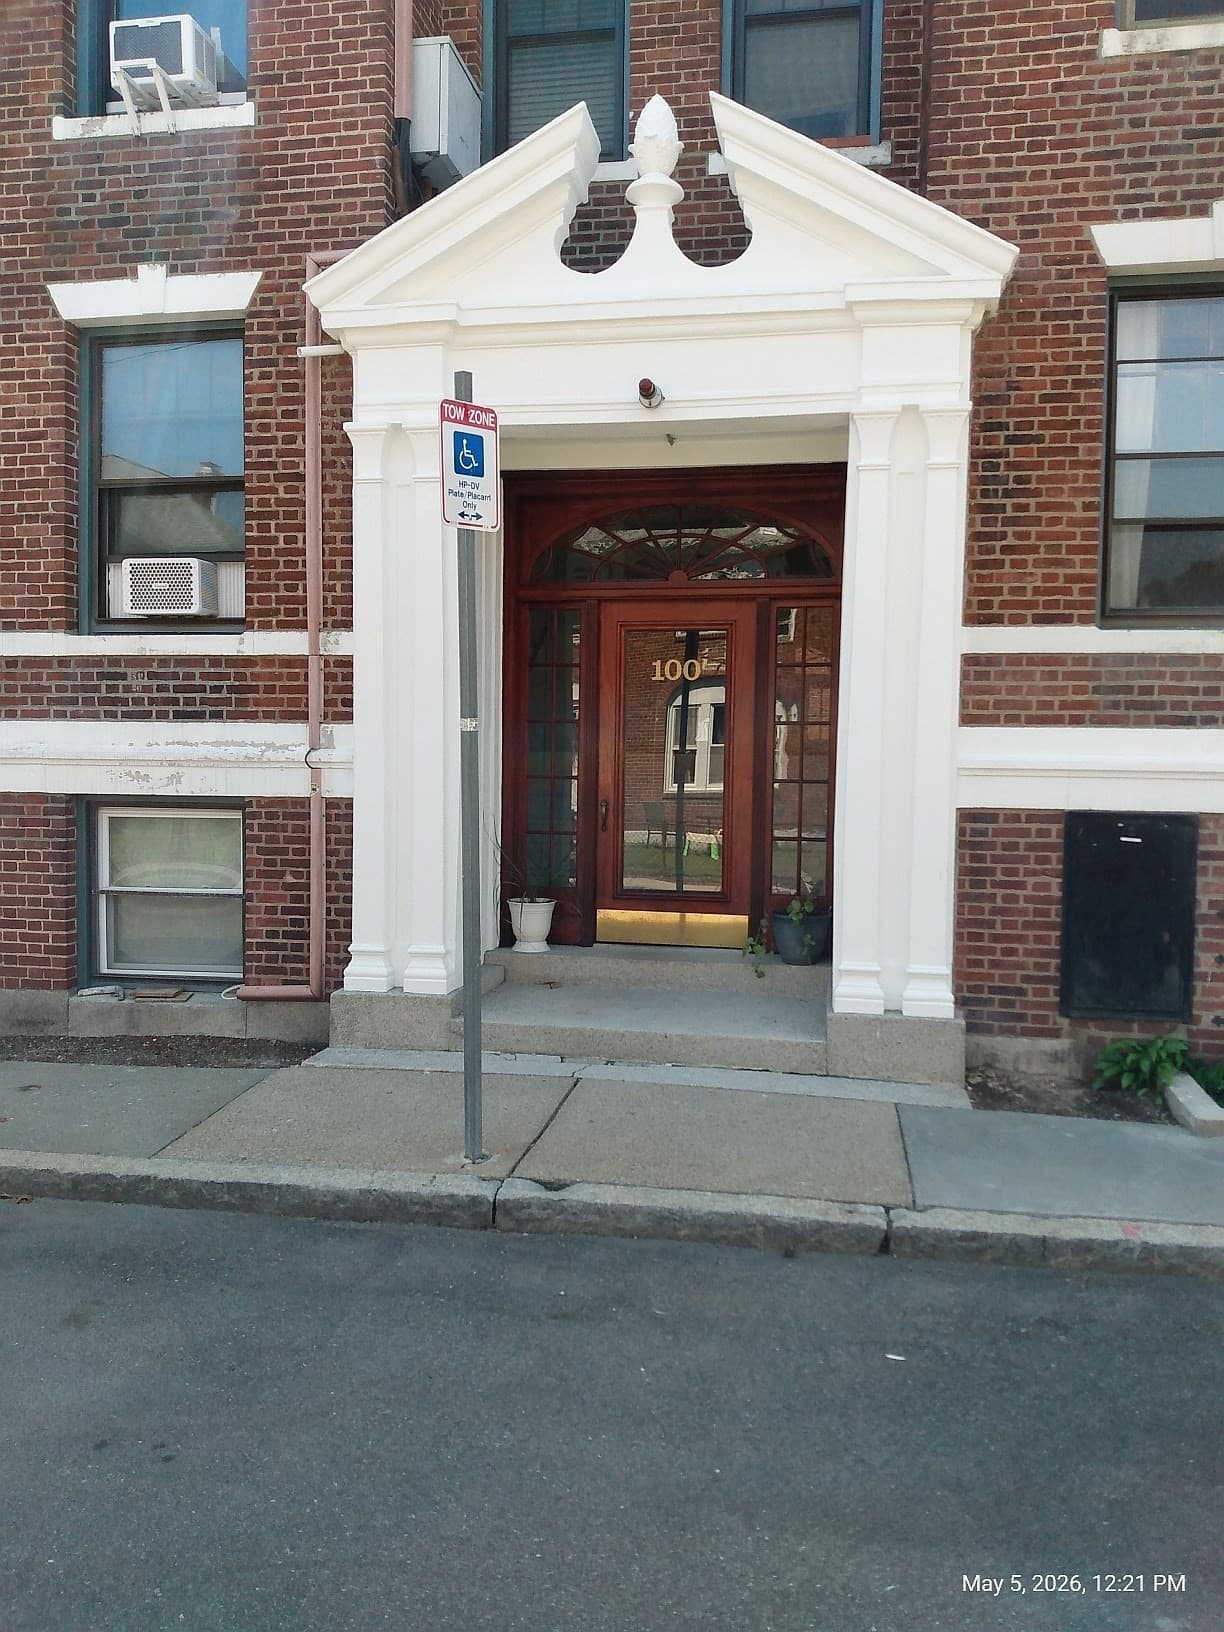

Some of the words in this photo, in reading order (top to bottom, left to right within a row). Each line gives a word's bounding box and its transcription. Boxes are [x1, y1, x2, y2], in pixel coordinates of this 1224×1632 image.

[442, 403, 465, 421] TOW
[469, 410, 496, 427] ZONE
[458, 480, 480, 490] HP-DV
[462, 501, 477, 511] Only
[651, 659, 701, 681] 100
